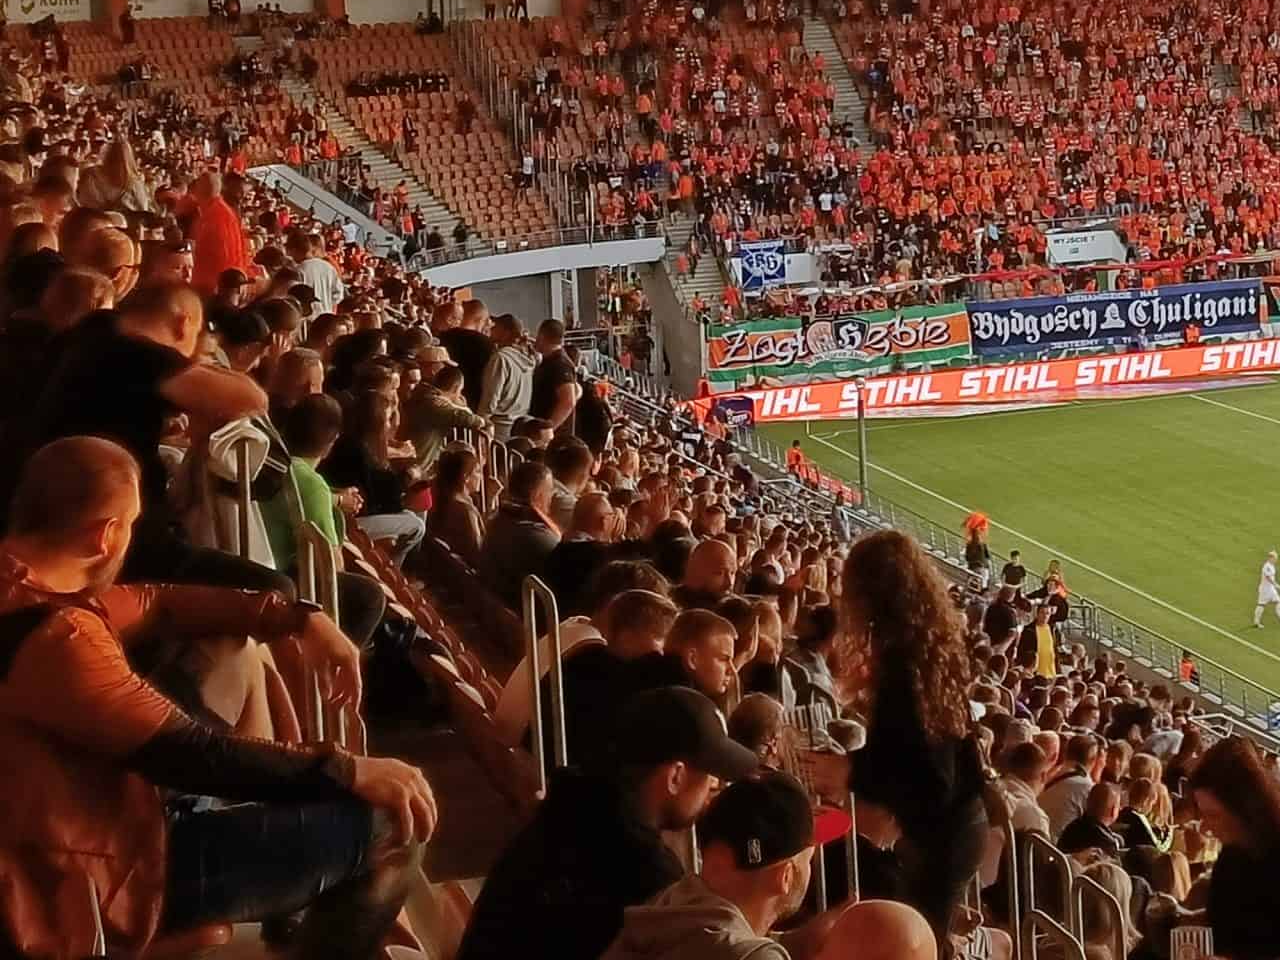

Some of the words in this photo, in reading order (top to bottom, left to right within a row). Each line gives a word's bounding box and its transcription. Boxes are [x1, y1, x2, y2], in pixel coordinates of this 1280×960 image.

[972, 306, 1097, 344] Bydgoscy
[1128, 289, 1256, 332] Chuligani
[744, 386, 821, 418] TIHL
[839, 376, 942, 409] STIHL
[959, 365, 1059, 397] STIHL
[1075, 353, 1172, 386] STIHL
